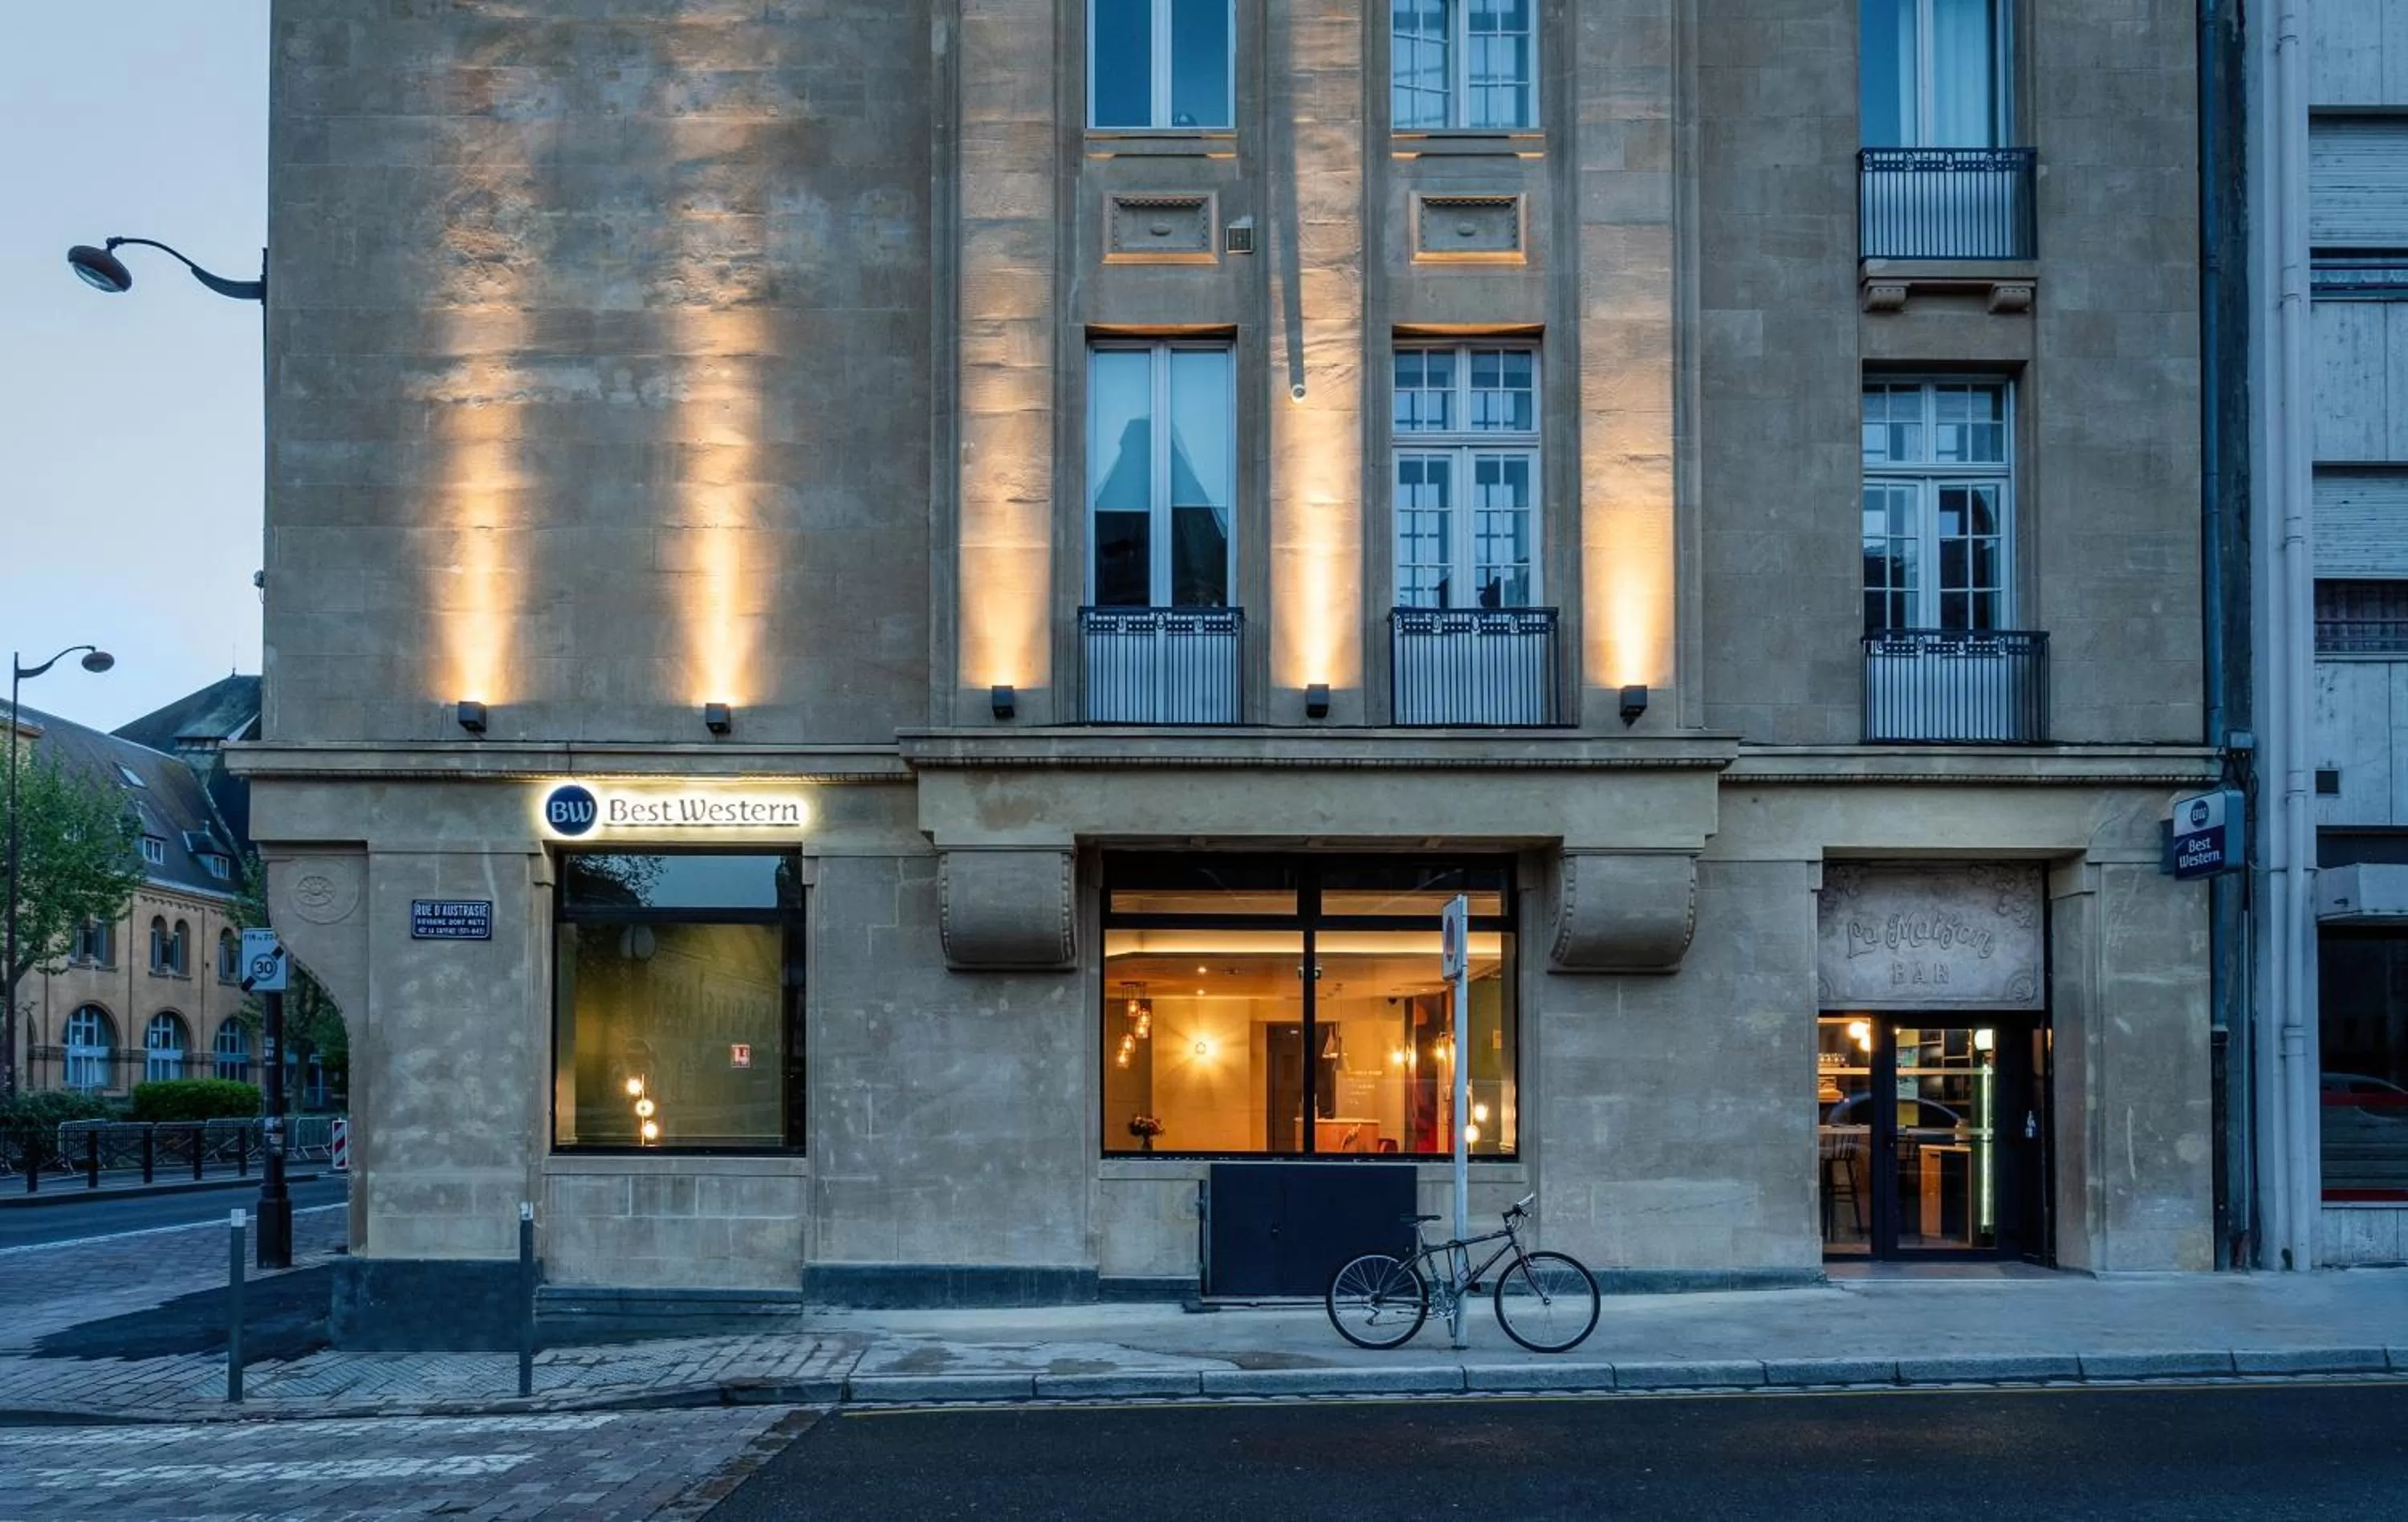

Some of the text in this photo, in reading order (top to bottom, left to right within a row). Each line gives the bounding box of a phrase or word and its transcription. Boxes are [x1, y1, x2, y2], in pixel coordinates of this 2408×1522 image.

[550, 800, 594, 824] BW
[608, 798, 800, 822] Best Western
[2189, 837, 2211, 853] Best
[415, 904, 433, 916] RUE
[1847, 912, 1994, 958] La Maison
[256, 961, 273, 974] 30
[1892, 962, 1950, 985] BAR
